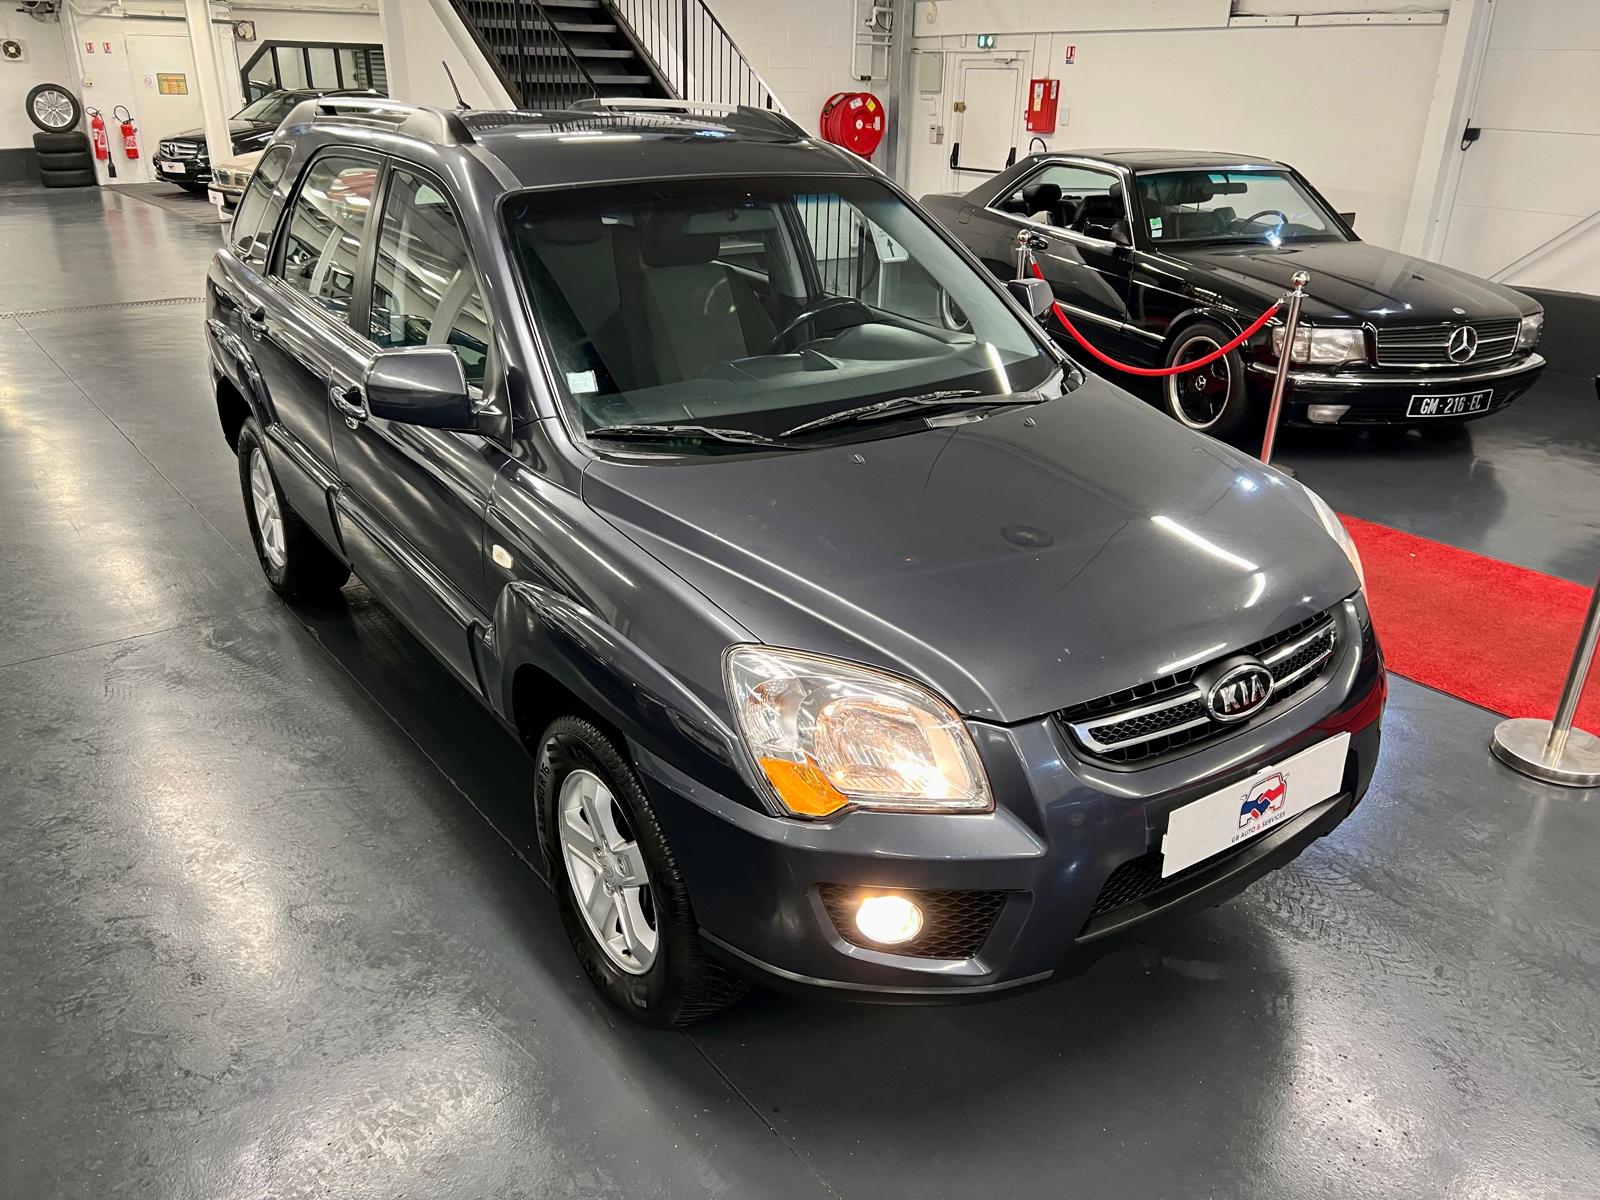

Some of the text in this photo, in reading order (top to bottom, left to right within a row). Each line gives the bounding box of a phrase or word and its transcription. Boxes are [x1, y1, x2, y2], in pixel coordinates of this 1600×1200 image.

[1220, 674, 1266, 713] KIA
[1231, 810, 1286, 843] GB AUTO & SERVICES
